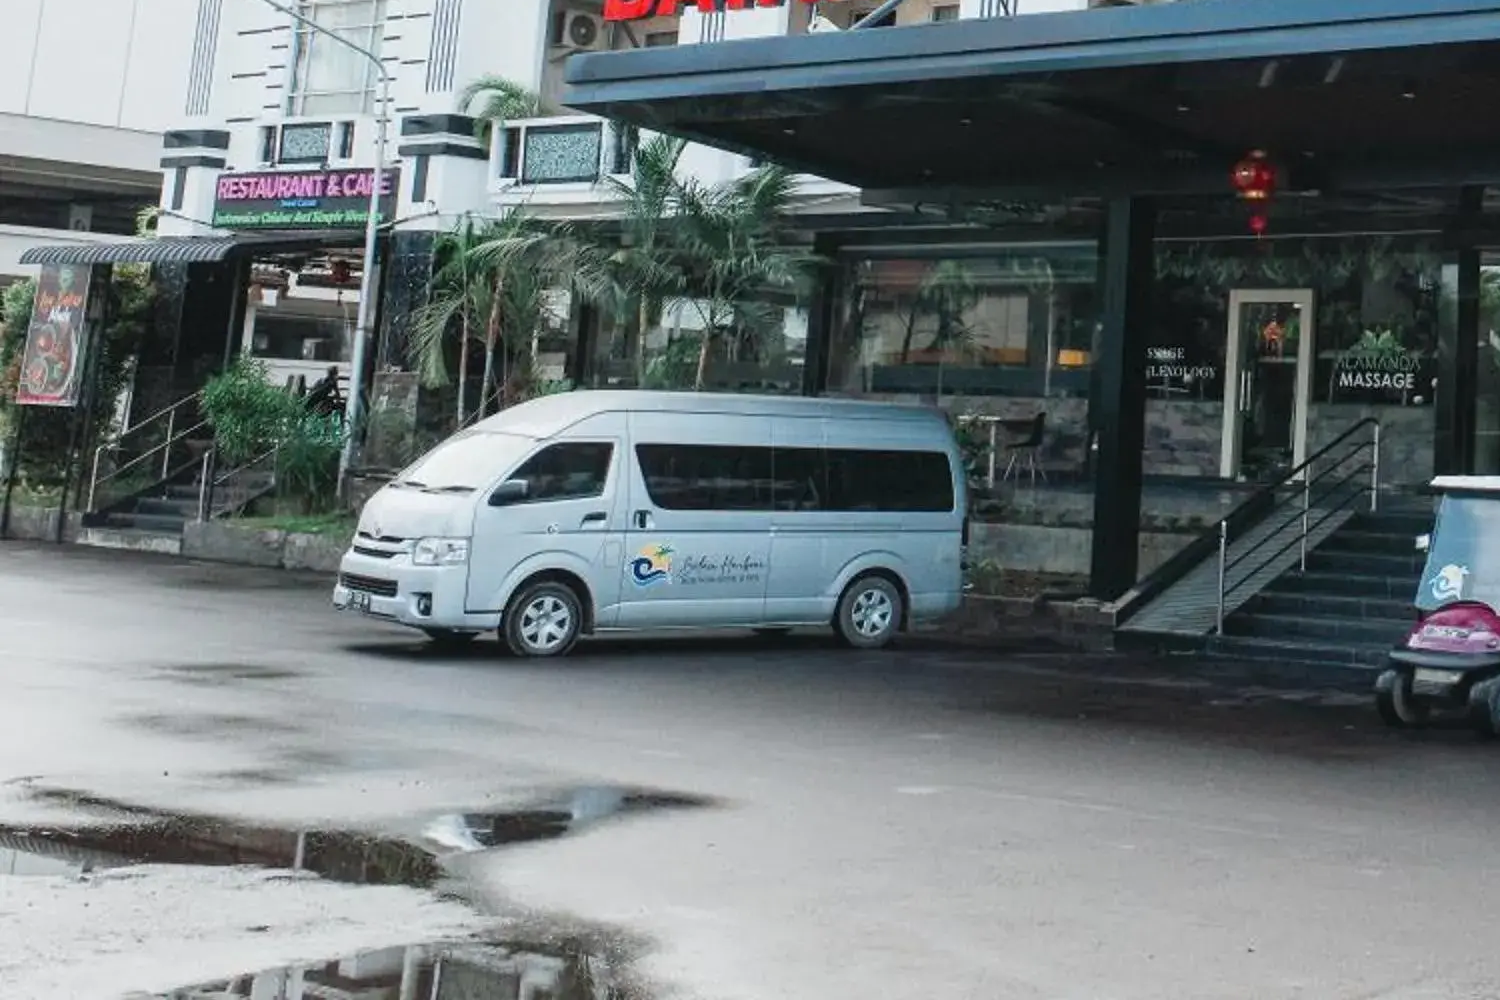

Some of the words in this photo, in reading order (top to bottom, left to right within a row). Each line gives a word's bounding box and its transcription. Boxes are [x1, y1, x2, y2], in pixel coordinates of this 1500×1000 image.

[218, 174, 325, 200] RESTAURANT
[327, 174, 342, 197] &
[1338, 371, 1415, 389] MASSAGE
